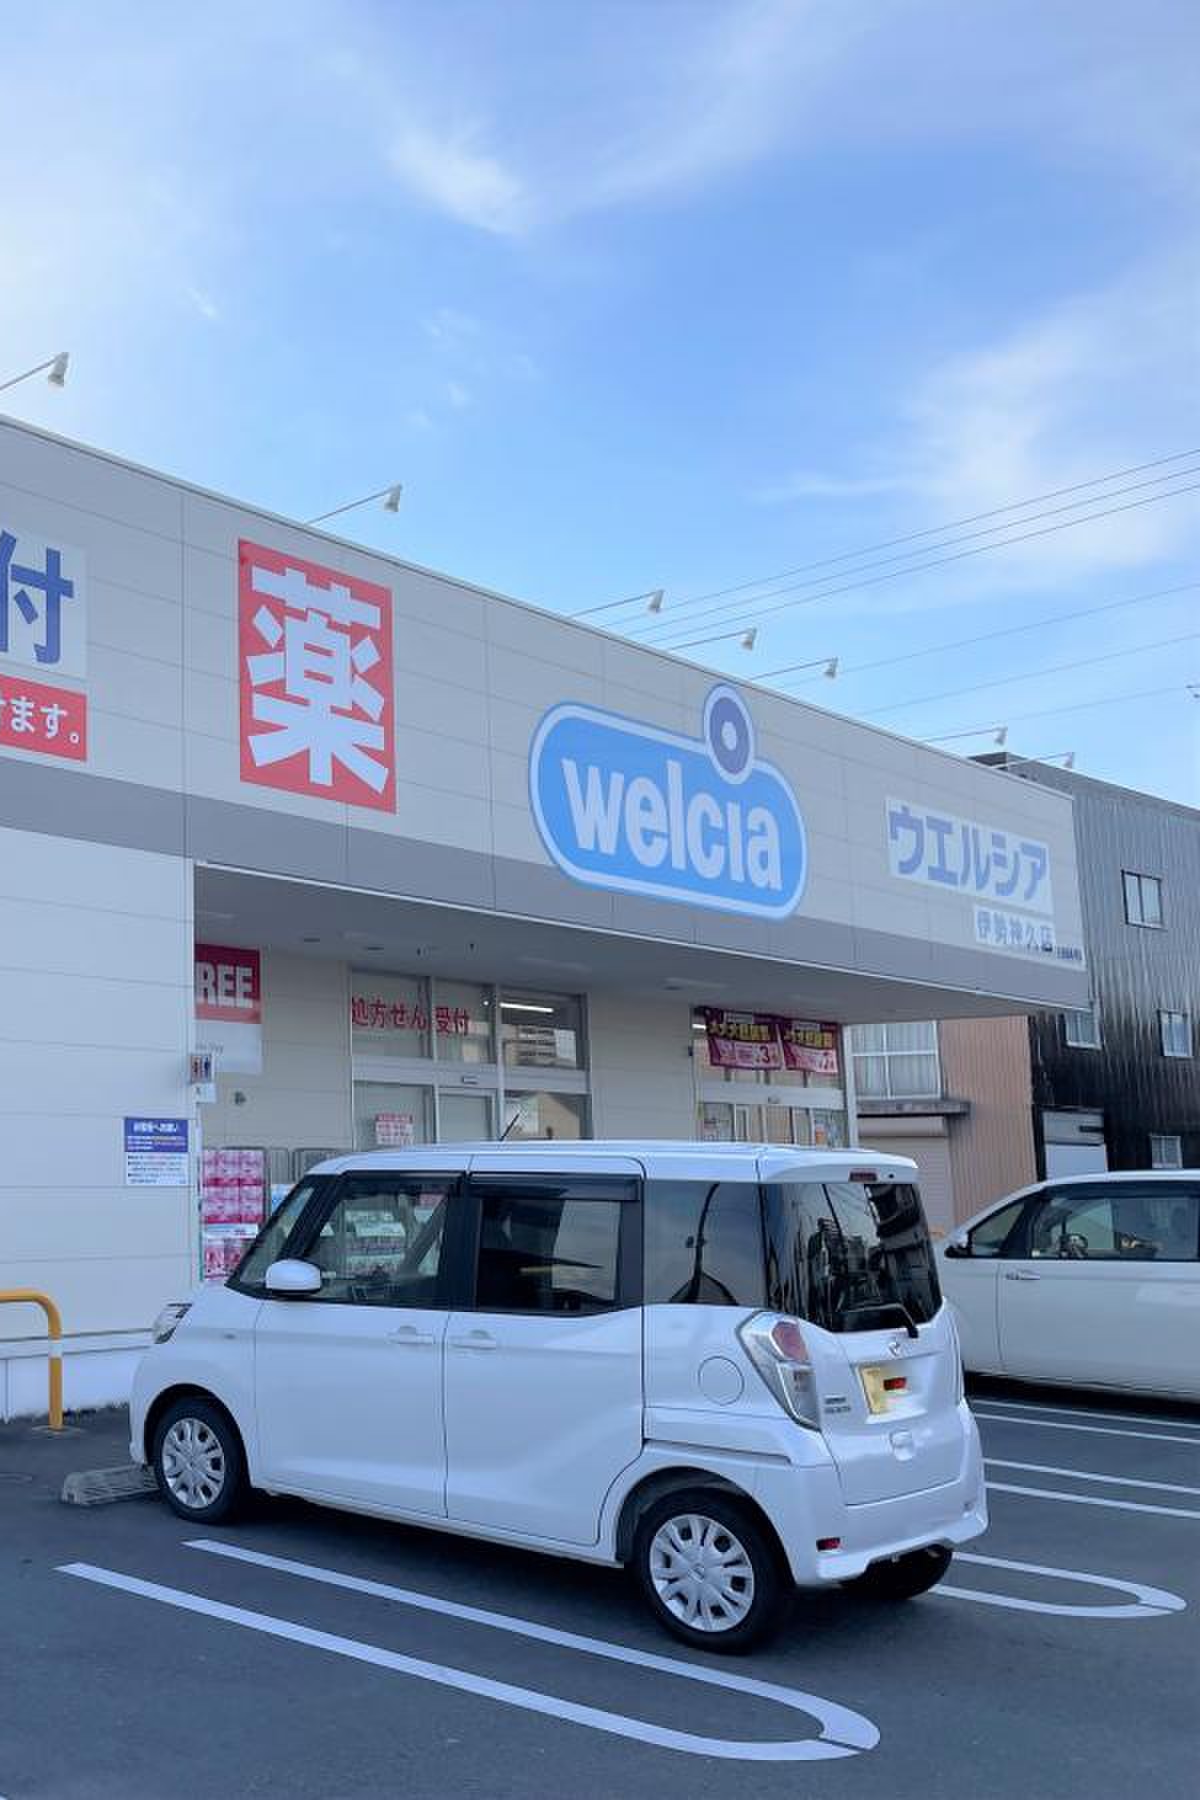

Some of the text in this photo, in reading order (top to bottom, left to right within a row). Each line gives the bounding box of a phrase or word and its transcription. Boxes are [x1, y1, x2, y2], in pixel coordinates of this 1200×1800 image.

[246, 566, 389, 794] 薬
[561, 758, 783, 890] welcia
[889, 805, 1047, 901] ウエルシア
